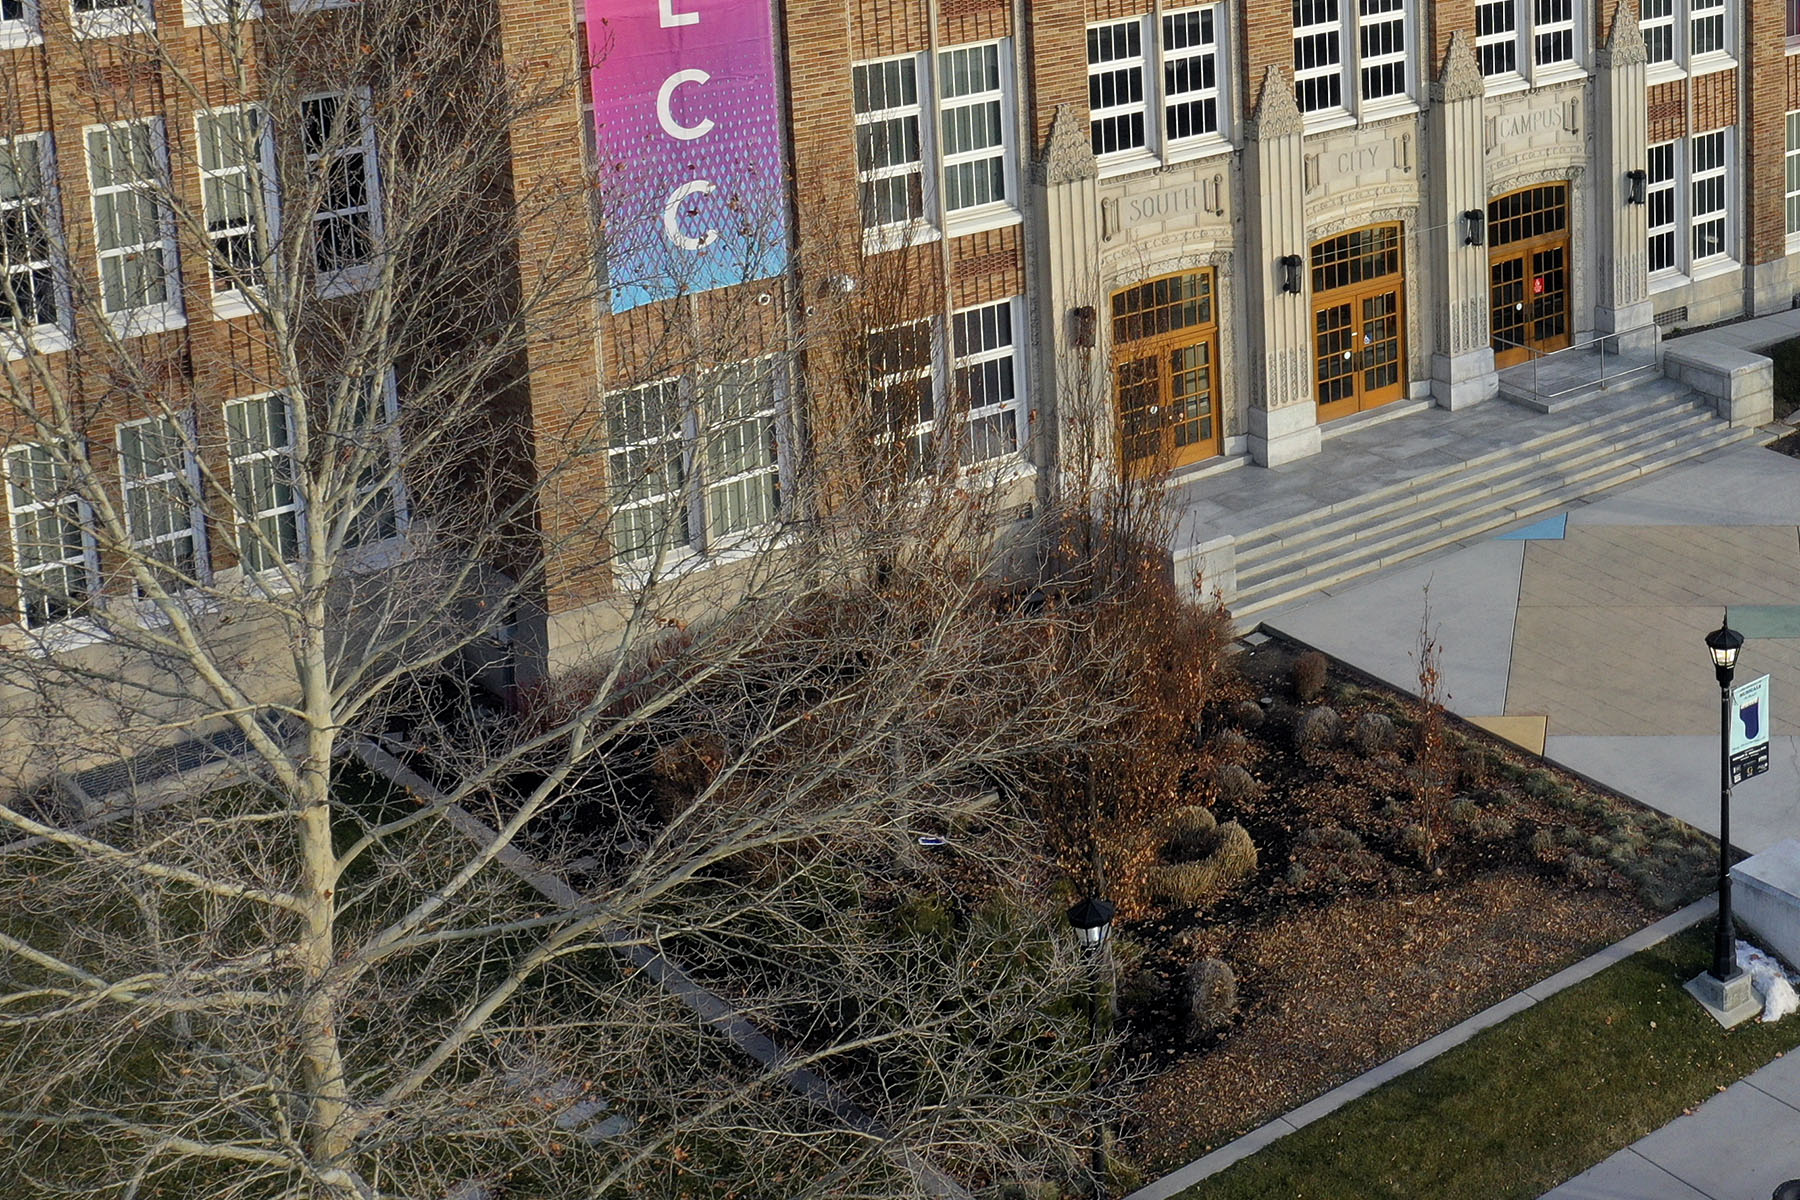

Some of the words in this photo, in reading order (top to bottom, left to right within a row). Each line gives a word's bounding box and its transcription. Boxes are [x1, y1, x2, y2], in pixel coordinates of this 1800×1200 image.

[1500, 109, 1562, 138] CAMPUS
[1337, 145, 1380, 175] CITY
[1129, 184, 1198, 222] SOUTH
